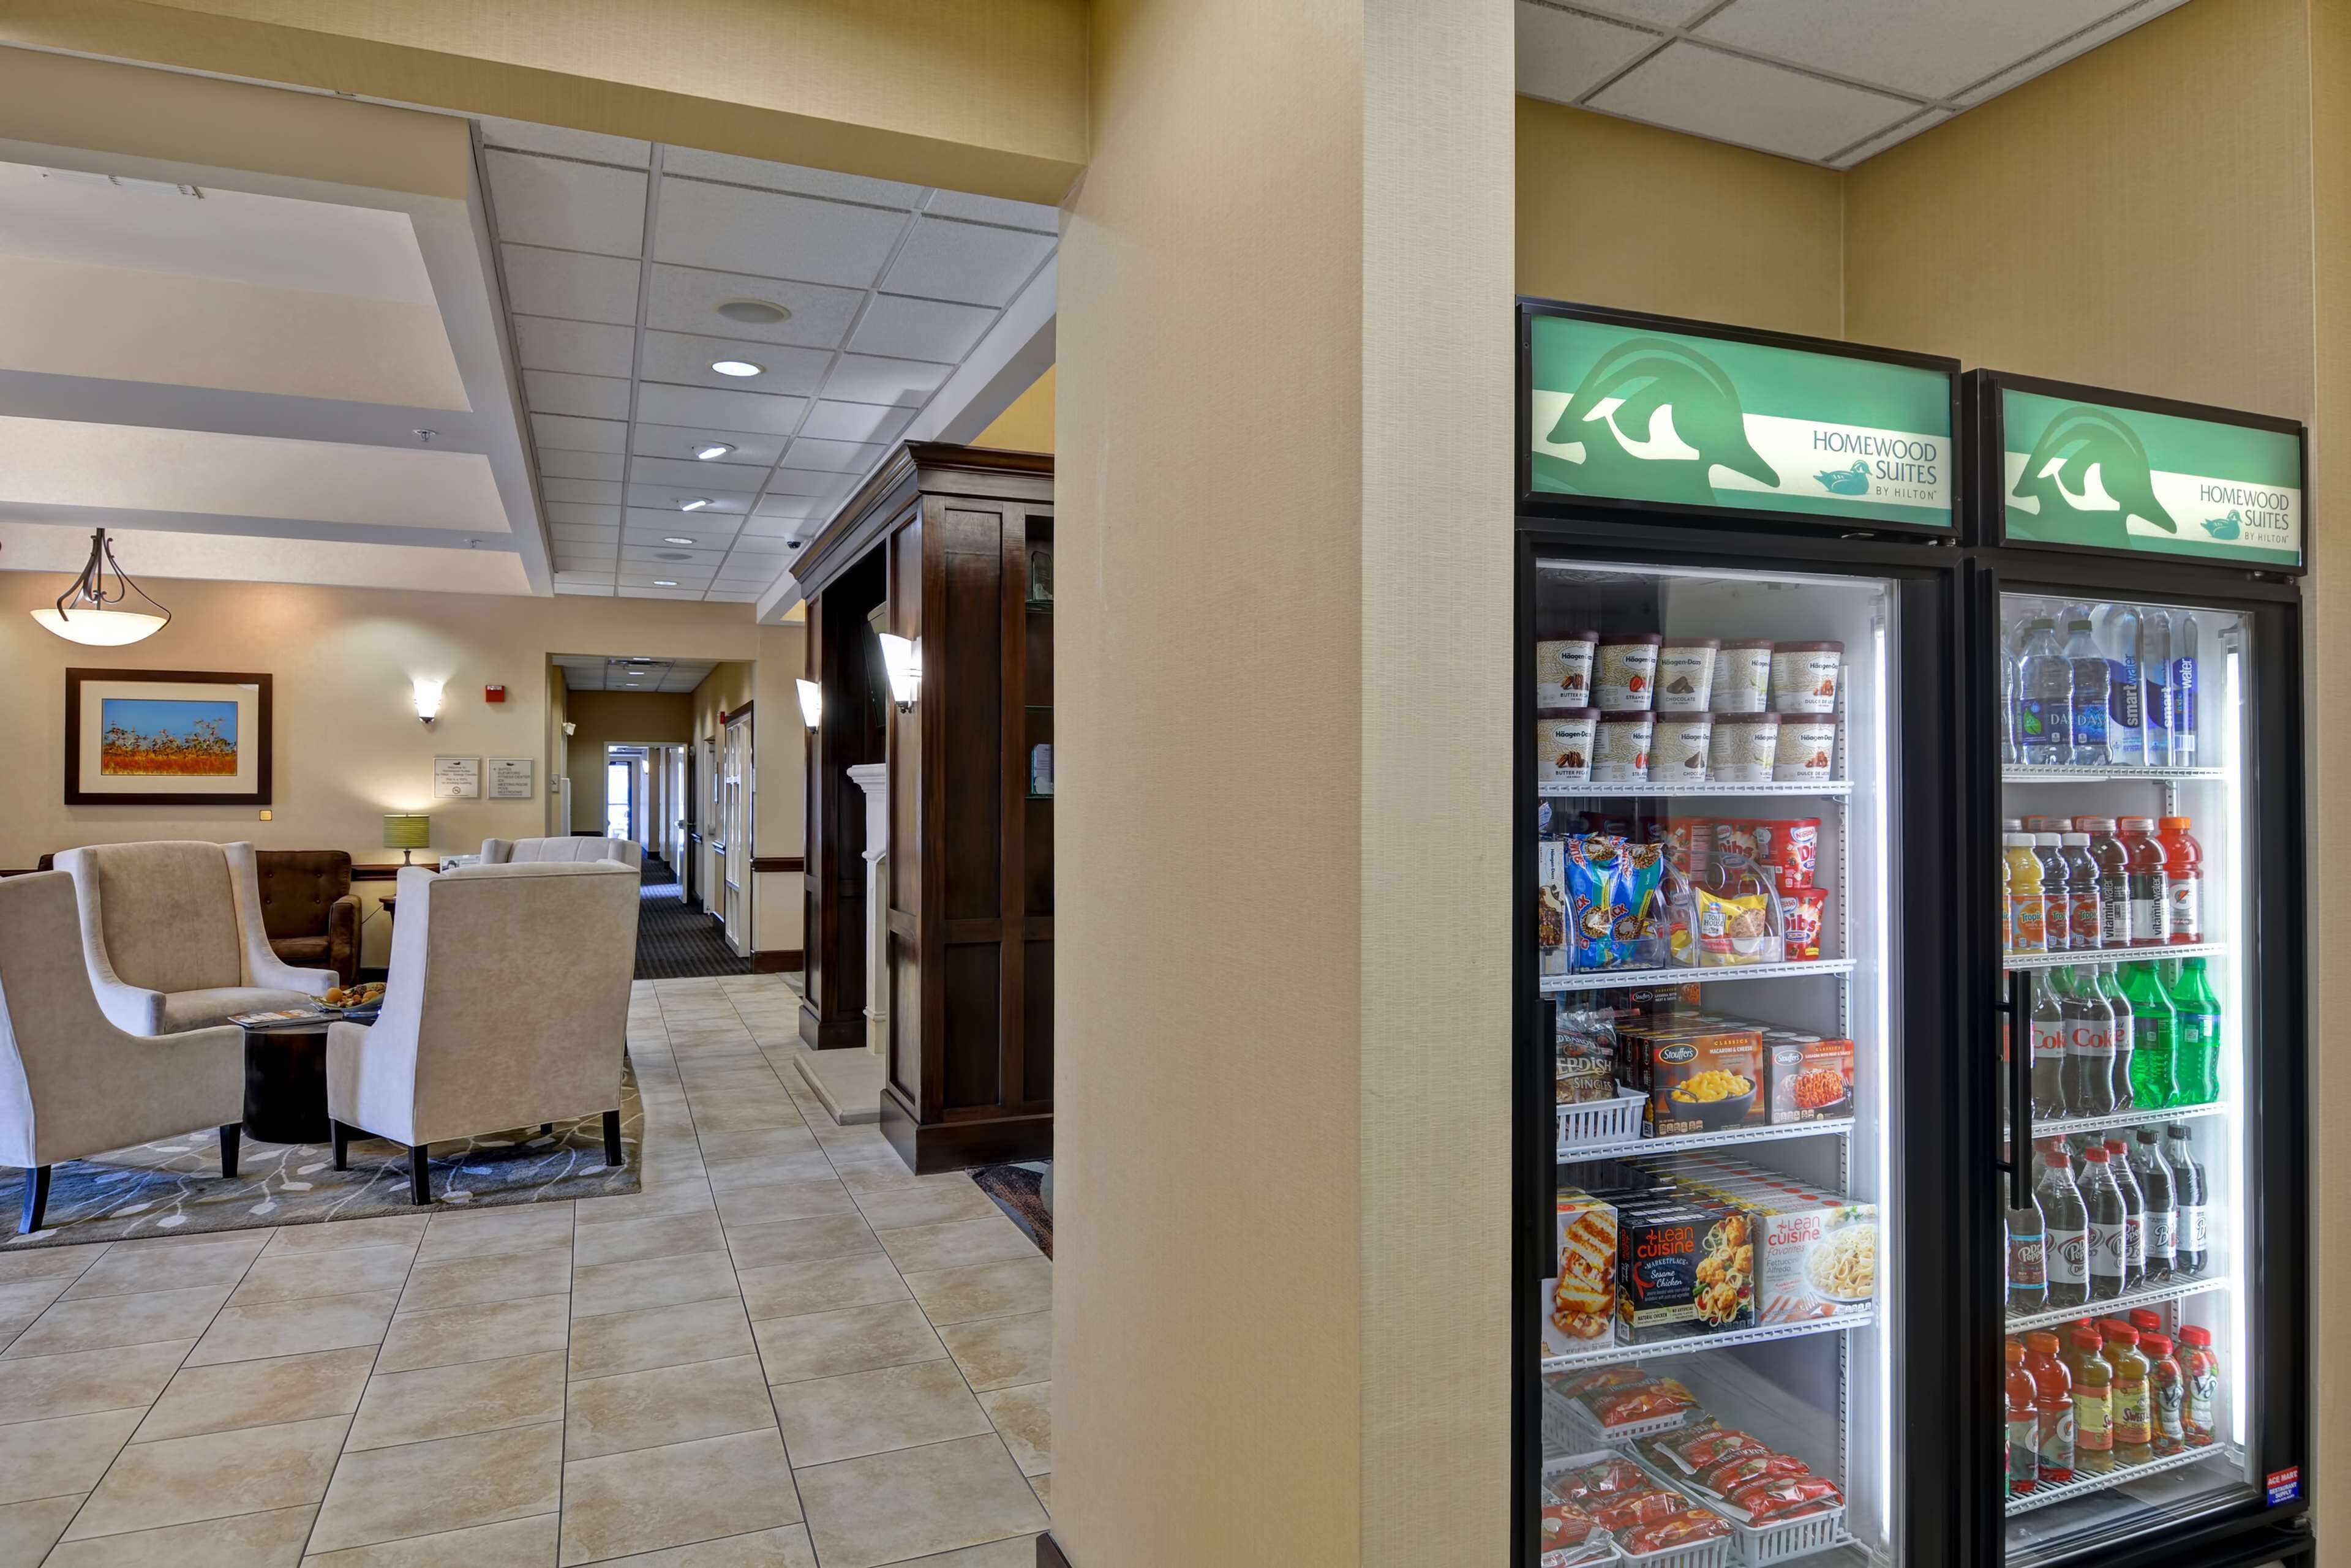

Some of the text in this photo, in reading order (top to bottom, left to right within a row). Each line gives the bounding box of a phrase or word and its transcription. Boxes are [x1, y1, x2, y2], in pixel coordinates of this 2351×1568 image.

[1813, 430, 1937, 462] HOMEWOOD
[1876, 460, 1937, 485] SUITES
[1876, 486, 1935, 500] BY HILTON
[2200, 484, 2289, 511] HOMEWOOD
[2244, 509, 2289, 531] SUITES
[2244, 531, 2287, 544] BY HILTON
[2050, 713, 2070, 725] DA
[2077, 712, 2106, 727] DAS
[2103, 879, 2113, 938] vitaminwater
[2151, 876, 2162, 936] vitaminwater
[1664, 1048, 1693, 1060] Stouffer's
[1646, 1257, 1687, 1269] MARKETPLACE
[1766, 1266, 1791, 1274] Alfredo
[1650, 1269, 1676, 1279] Sesame
[1656, 1277, 1683, 1288] Chicken
[2193, 1375, 2217, 1399] V8
[2160, 1386, 2182, 1408] V8
[2268, 1470, 2298, 1486] ACE MART
